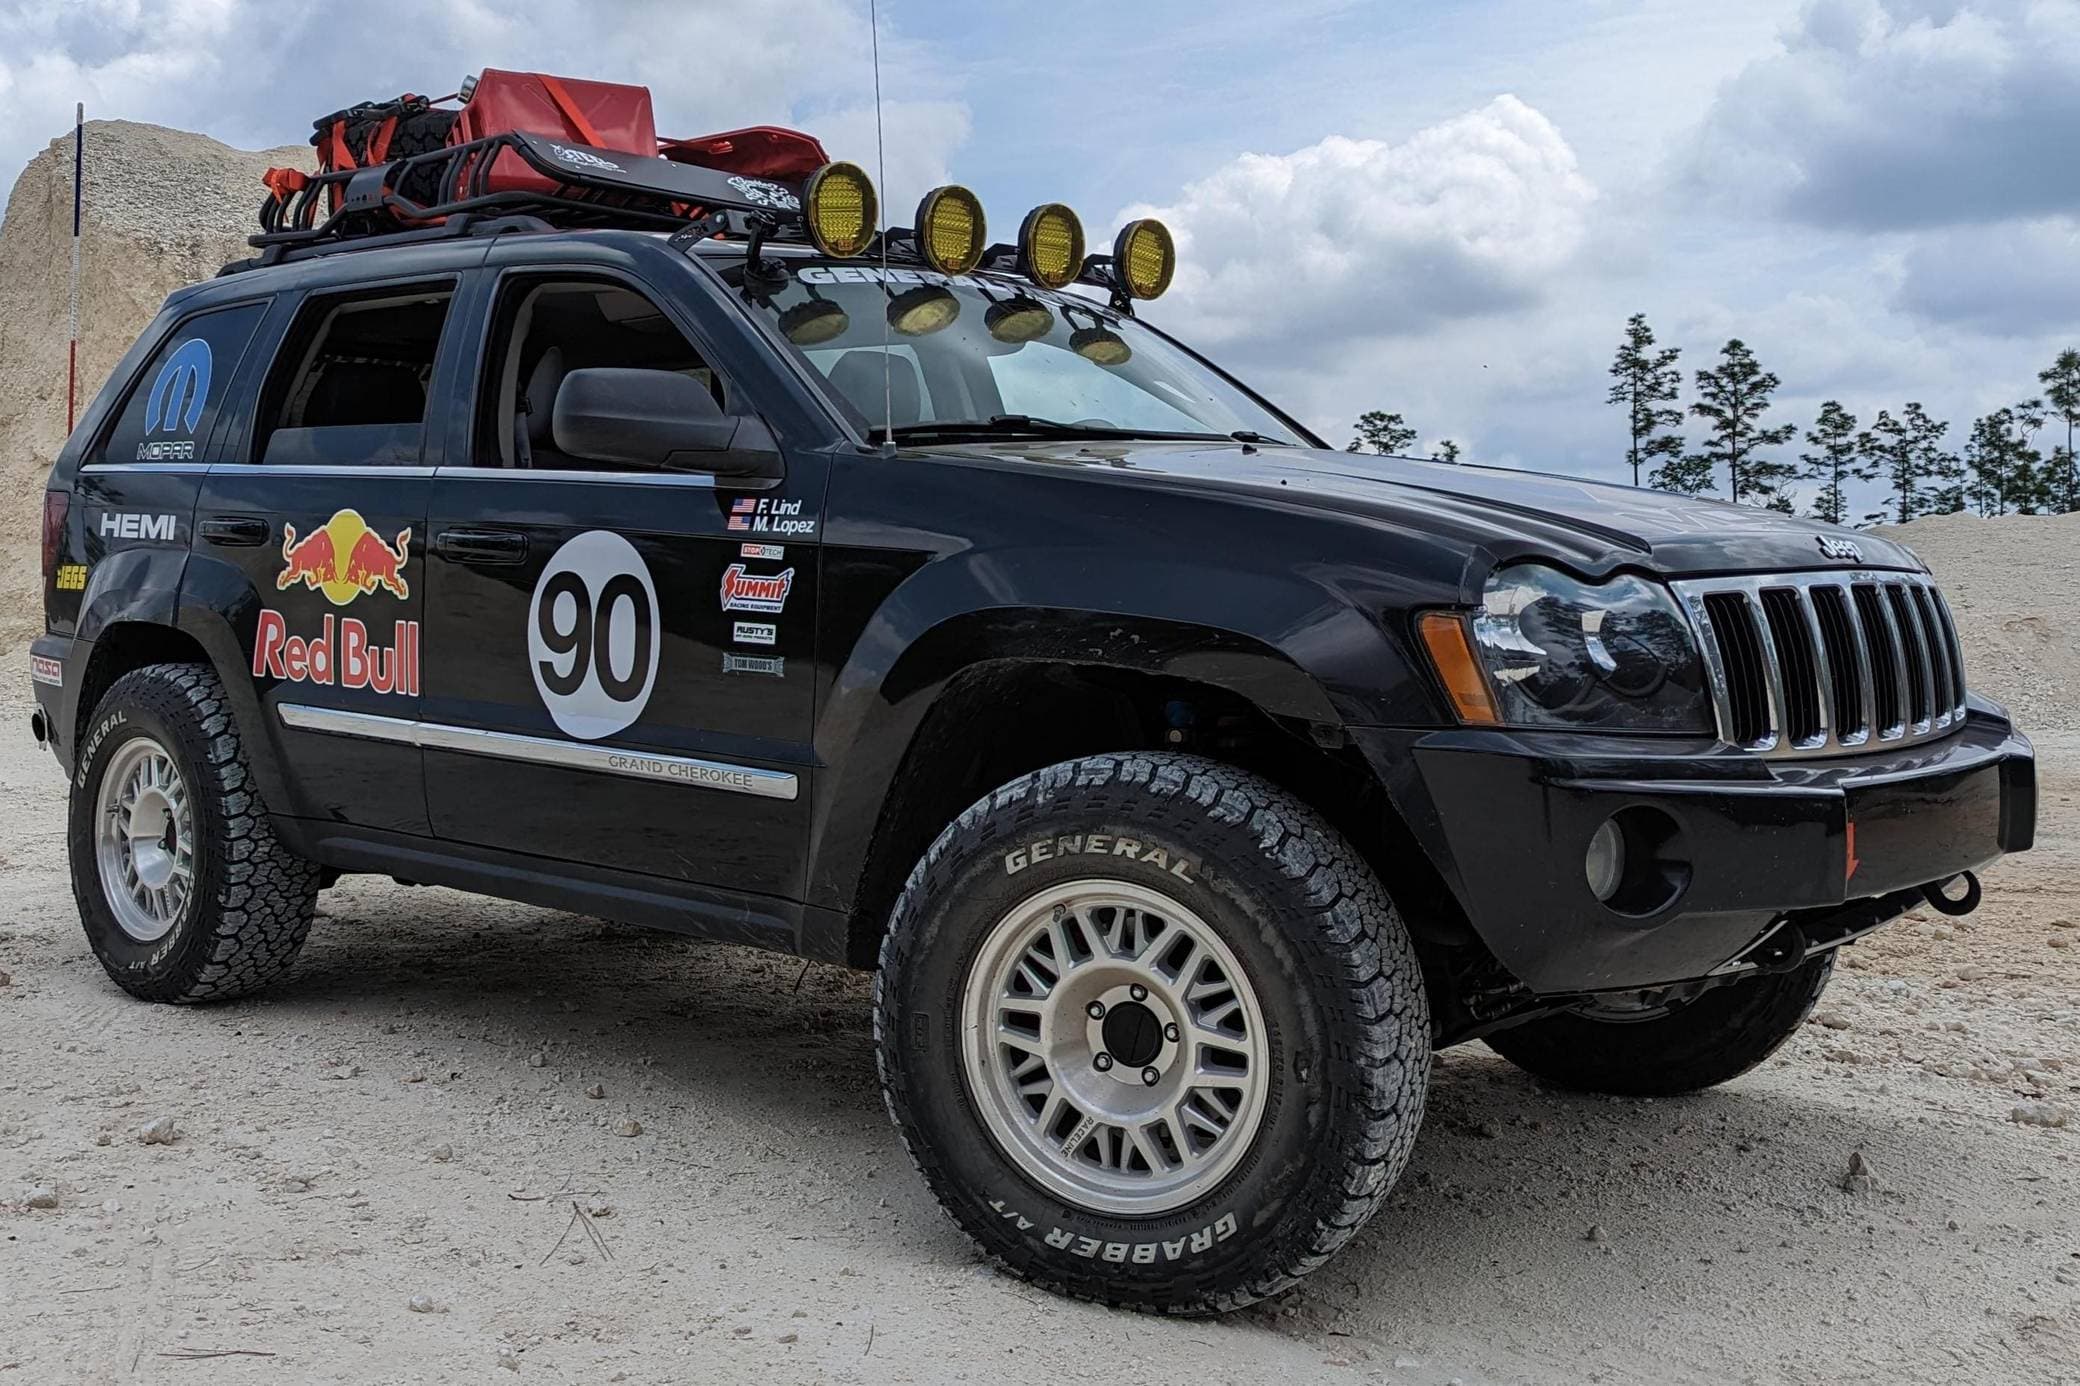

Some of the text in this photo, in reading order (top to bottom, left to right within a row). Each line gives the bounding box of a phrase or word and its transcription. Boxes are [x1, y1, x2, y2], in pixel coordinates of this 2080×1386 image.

[136, 441, 195, 460] MOPAR
[757, 498, 802, 515] F. Lind
[100, 512, 176, 541] HEMI
[752, 515, 816, 536] M. Lopez
[1815, 535, 1864, 563] Jeep
[56, 565, 88, 590] JEGS
[538, 570, 652, 703] 90
[736, 625, 774, 636] RUSTY'S
[253, 608, 419, 697] Red Bull
[77, 710, 127, 789] GENERAL
[608, 755, 753, 787] GRAND CHEROKEE
[1004, 834, 1195, 885] GENERAL
[1060, 1116, 1095, 1158] RACELINE
[988, 1200, 1036, 1231] A/T
[1044, 1212, 1238, 1264] GRABBER
